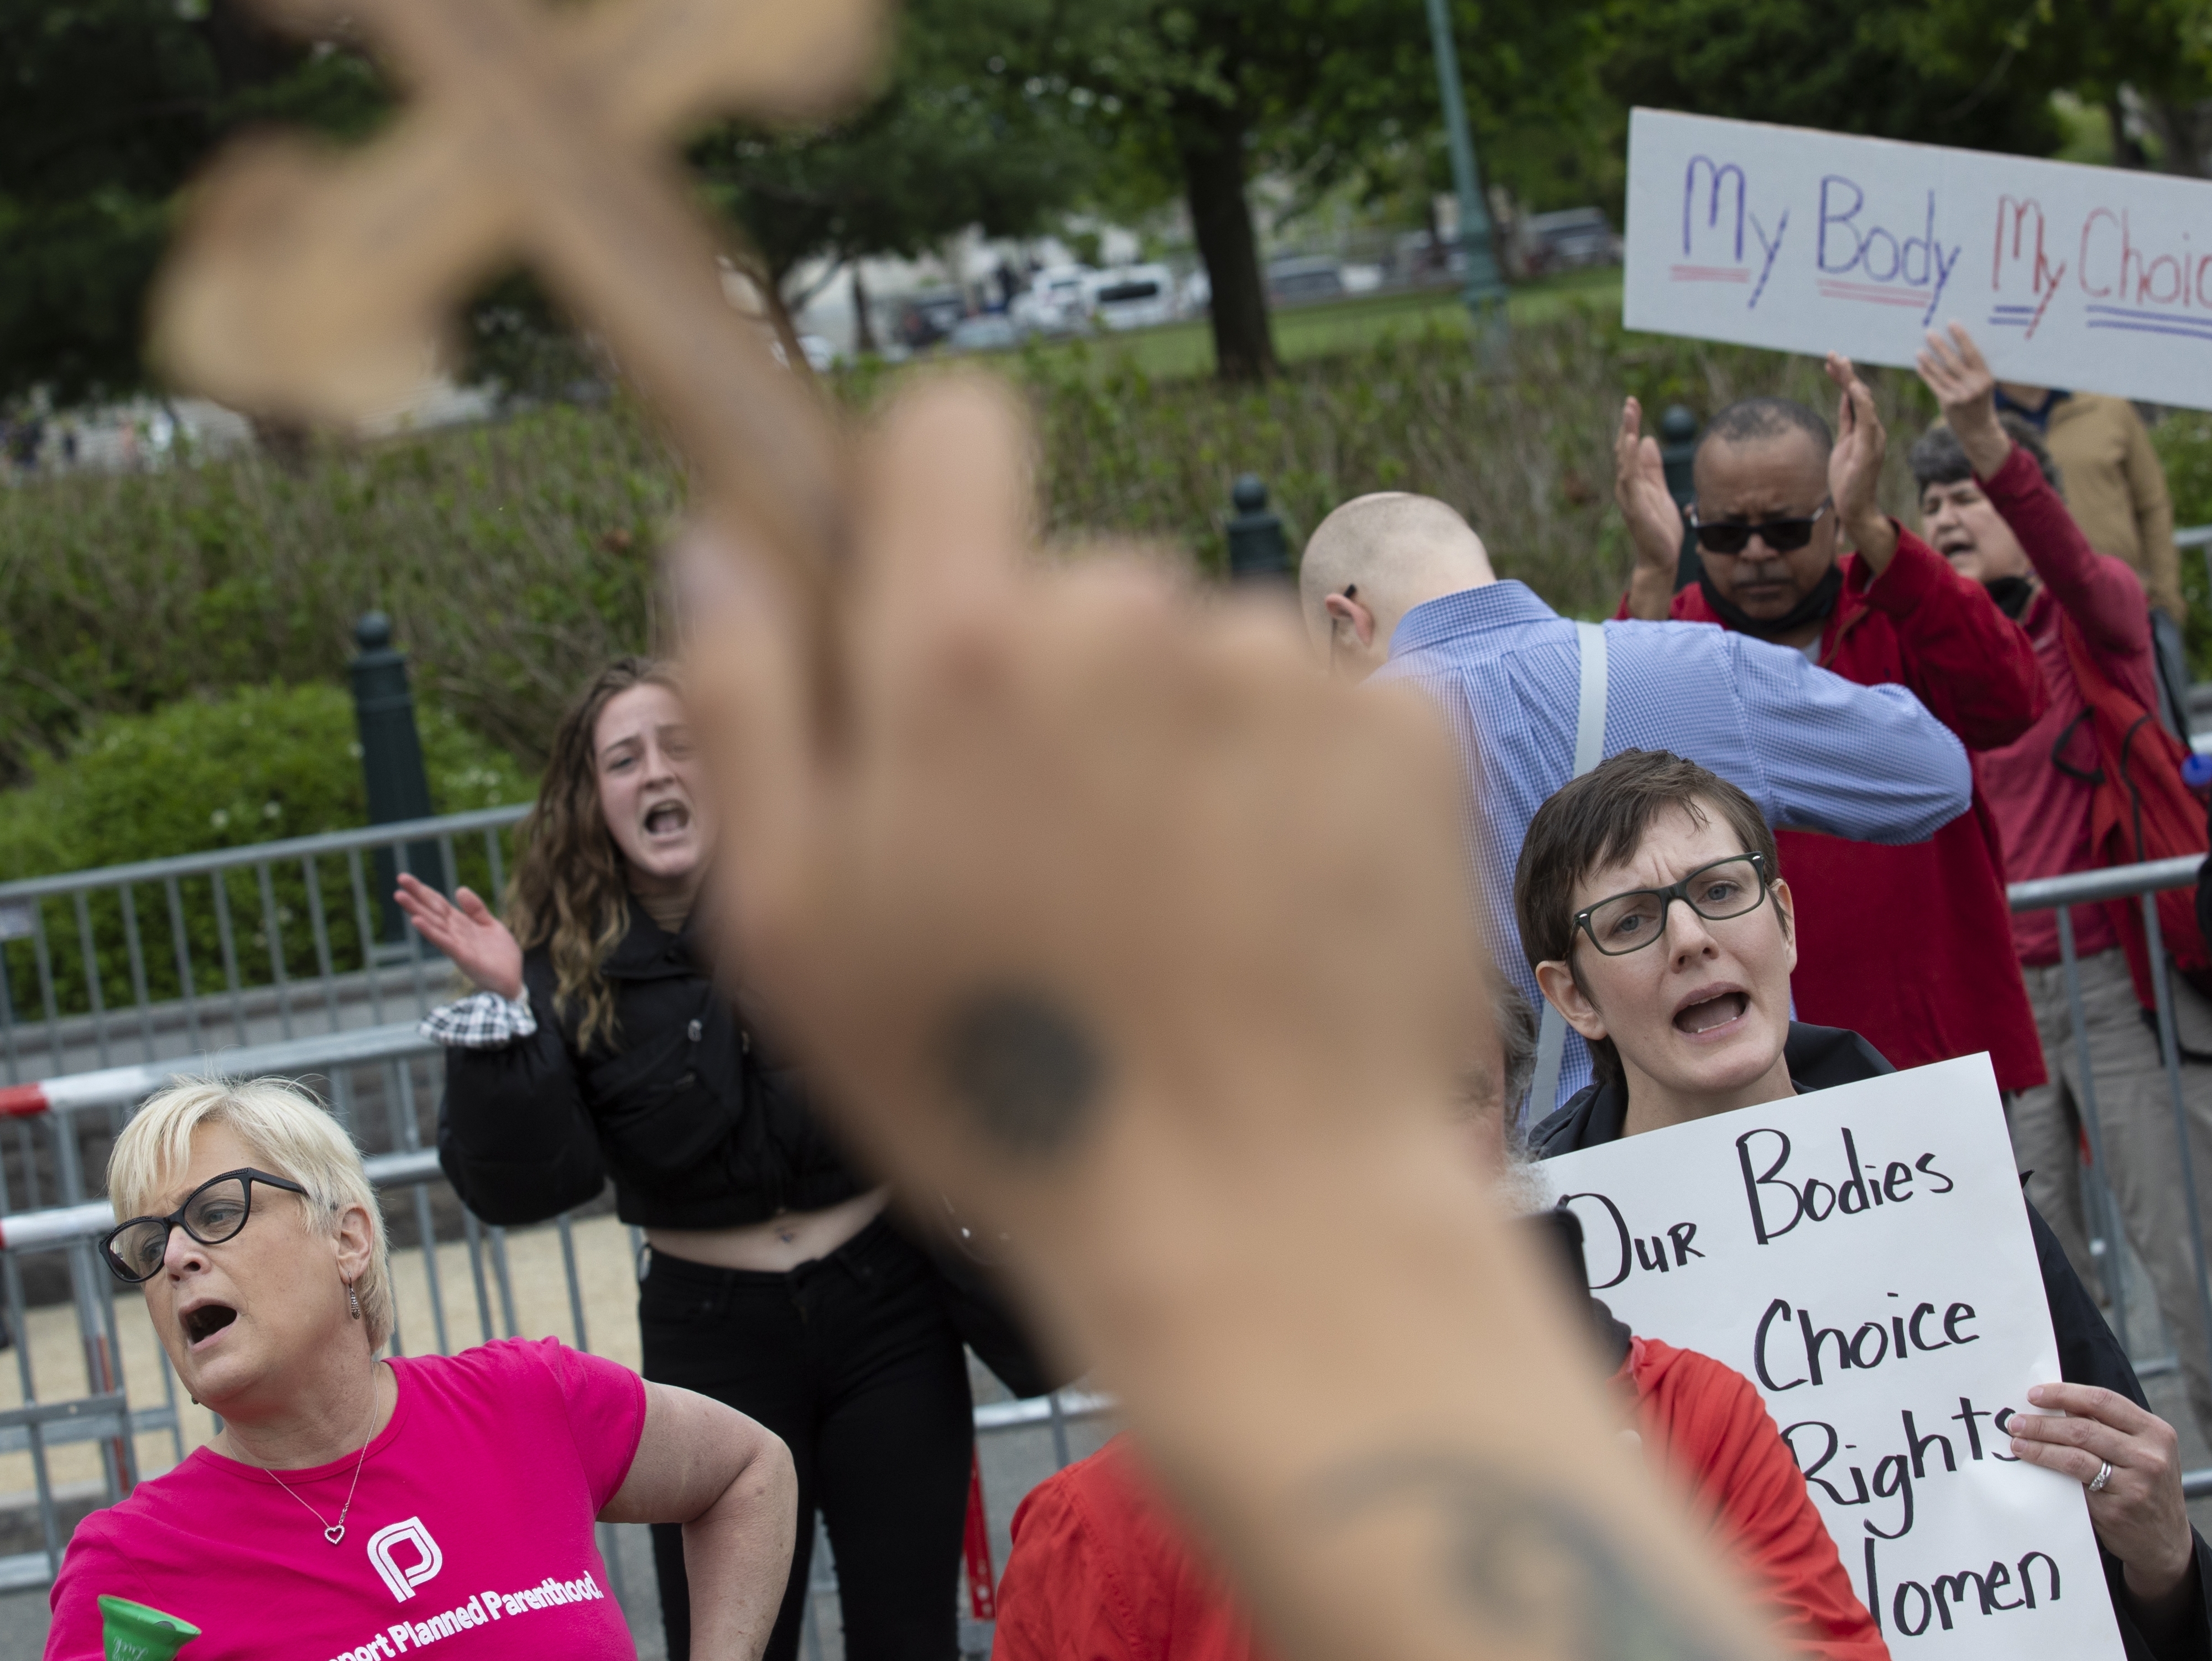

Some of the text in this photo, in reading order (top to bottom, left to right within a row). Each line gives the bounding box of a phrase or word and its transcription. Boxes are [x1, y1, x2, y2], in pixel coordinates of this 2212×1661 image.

[1682, 154, 1790, 309] My
[1817, 174, 1961, 326] Body
[1992, 194, 2066, 340] My
[1735, 1127, 1954, 1245] Bodies
[1753, 1293, 1980, 1391] Choice
[1780, 1397, 2022, 1540] Rights
[387, 1595, 489, 1653] Planned
